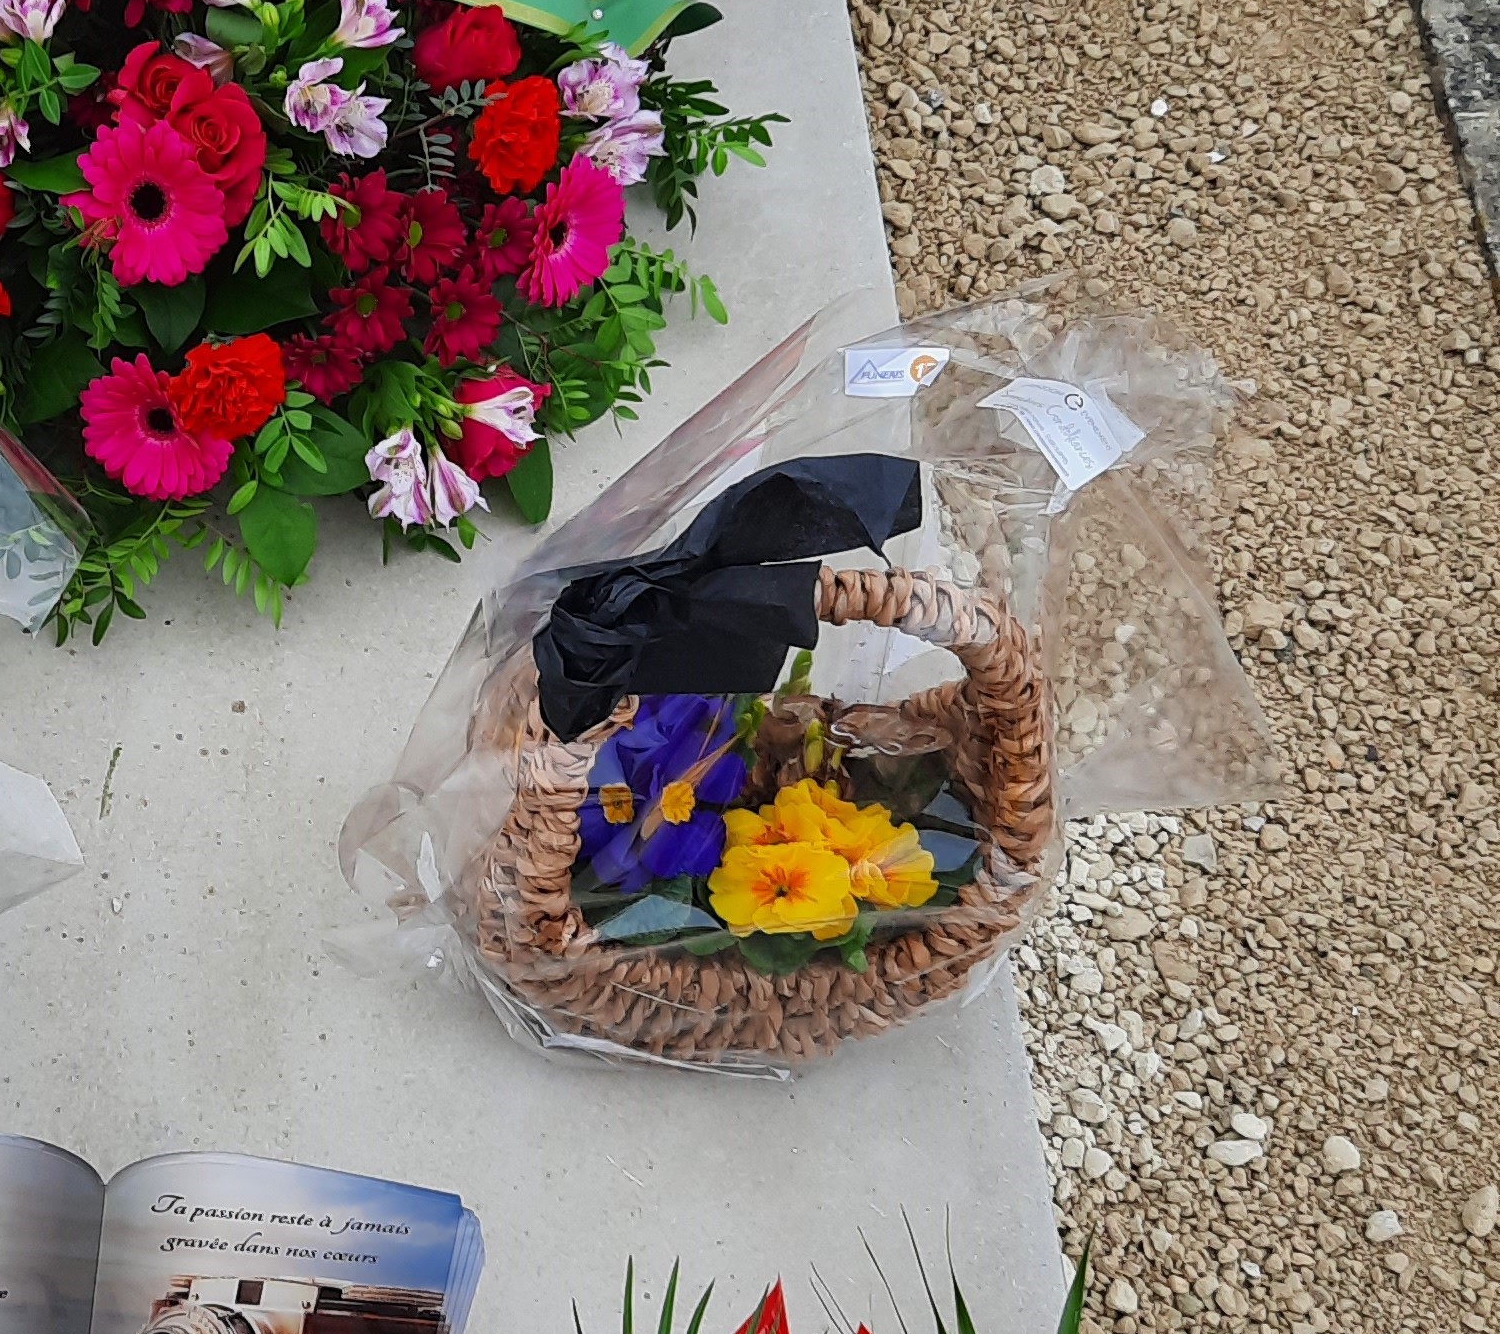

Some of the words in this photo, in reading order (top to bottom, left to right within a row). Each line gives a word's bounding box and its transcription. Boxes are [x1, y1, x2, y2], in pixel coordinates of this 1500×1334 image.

[150, 1194, 186, 1216] Ta
[189, 1207, 264, 1223] passion
[270, 1213, 314, 1227] reste
[318, 1215, 333, 1228] à
[330, 1218, 411, 1235] jamais
[160, 1235, 229, 1252] gravée
[234, 1232, 280, 1255] dans
[285, 1246, 317, 1259] nos
